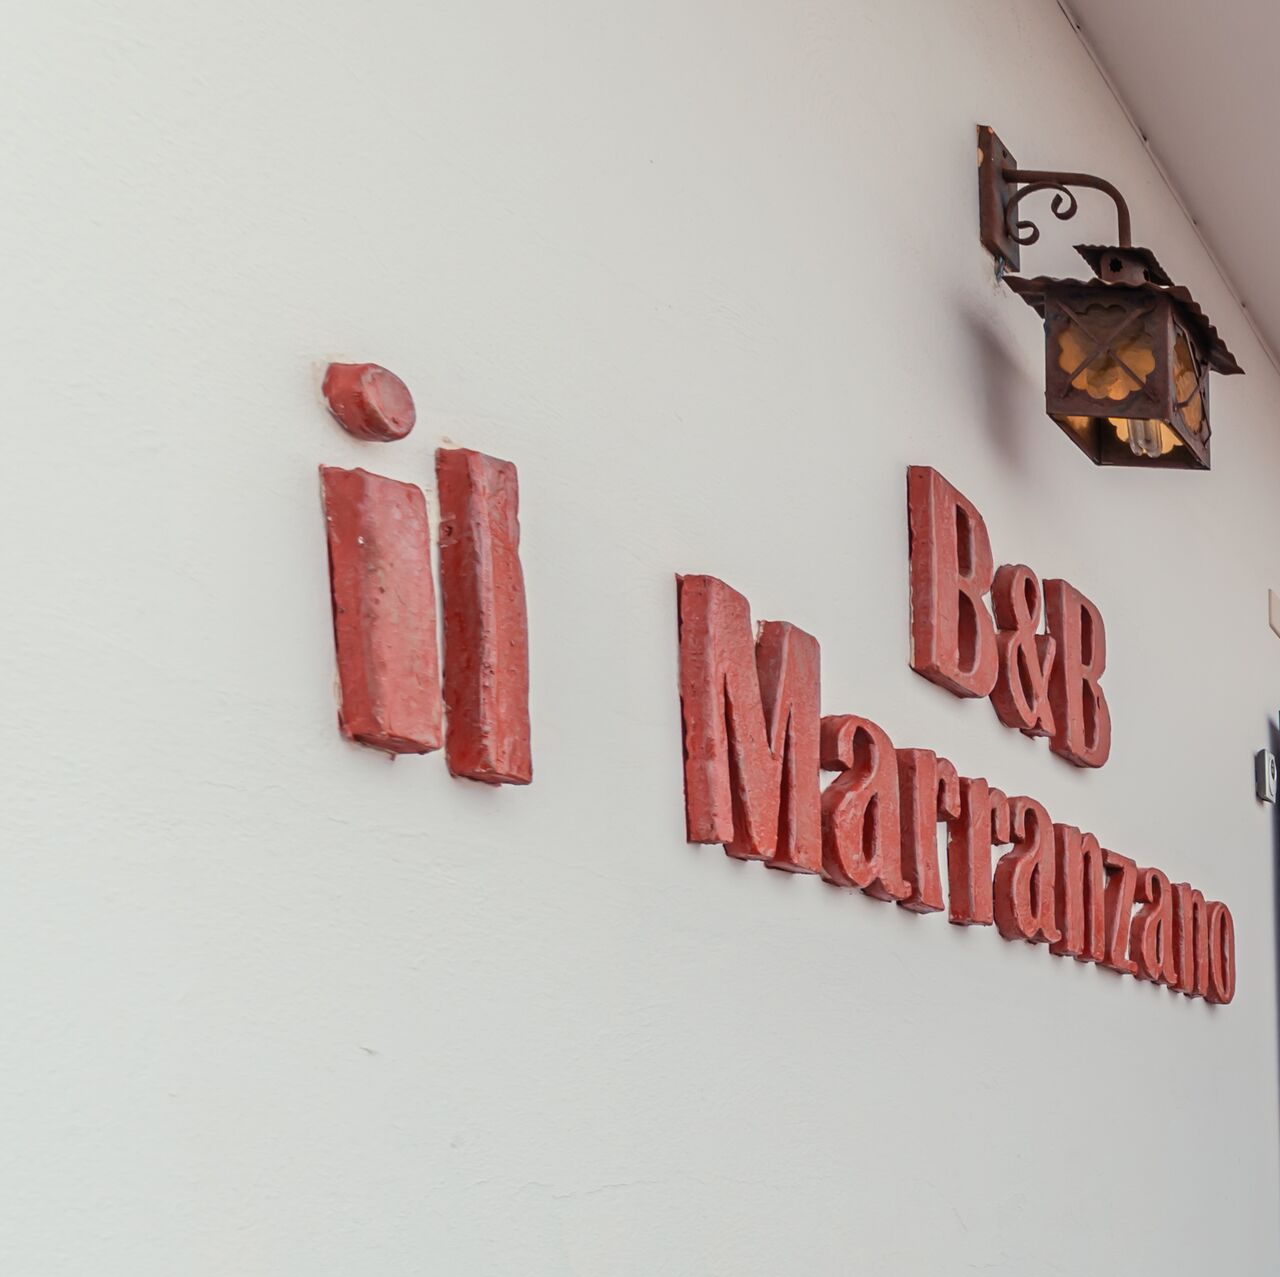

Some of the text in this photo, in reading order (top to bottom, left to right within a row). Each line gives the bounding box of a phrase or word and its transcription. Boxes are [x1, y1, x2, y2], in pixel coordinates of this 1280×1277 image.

[318, 362, 533, 786] il
[907, 466, 1112, 769] B&B
[675, 573, 1235, 1004] Marranzano
